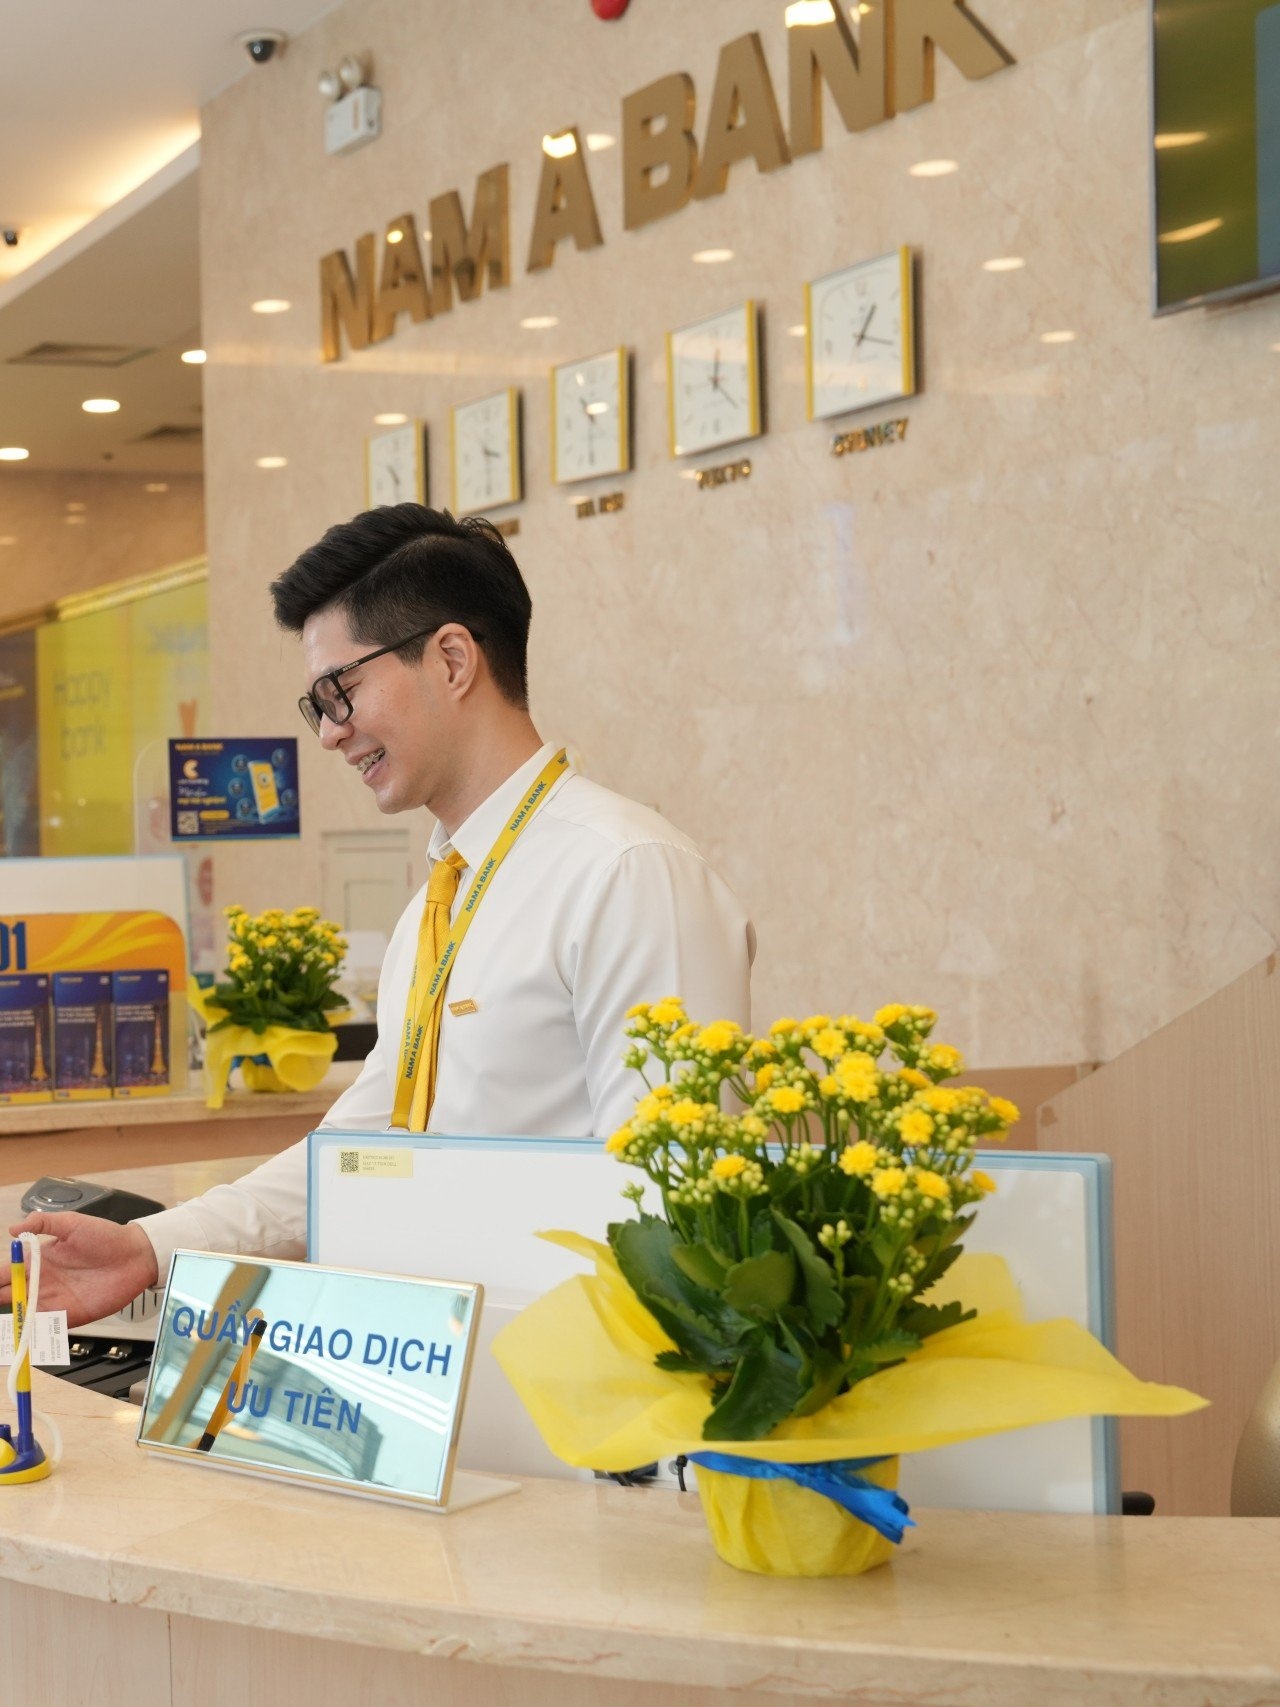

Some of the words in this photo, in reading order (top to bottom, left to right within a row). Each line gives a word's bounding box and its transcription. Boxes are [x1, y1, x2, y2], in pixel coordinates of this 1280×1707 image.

[320, 162, 511, 363] NAM
[526, 126, 604, 274] A
[622, 0, 1017, 231] BANK
[510, 810, 526, 831] NAM
[528, 781, 546, 804] BANK
[466, 890, 479, 912] NAM
[480, 858, 496, 883] BANK
[429, 974, 441, 996] NAM
[441, 940, 456, 966] BANK
[405, 1057, 416, 1079] NAM
[413, 1025, 424, 1049] BANK
[173, 1300, 261, 1346] QUẦY
[269, 1320, 353, 1360] GIAO
[363, 1333, 452, 1376] DỊCH
[227, 1379, 273, 1418] ƯU
[284, 1387, 362, 1433] TIÊN
